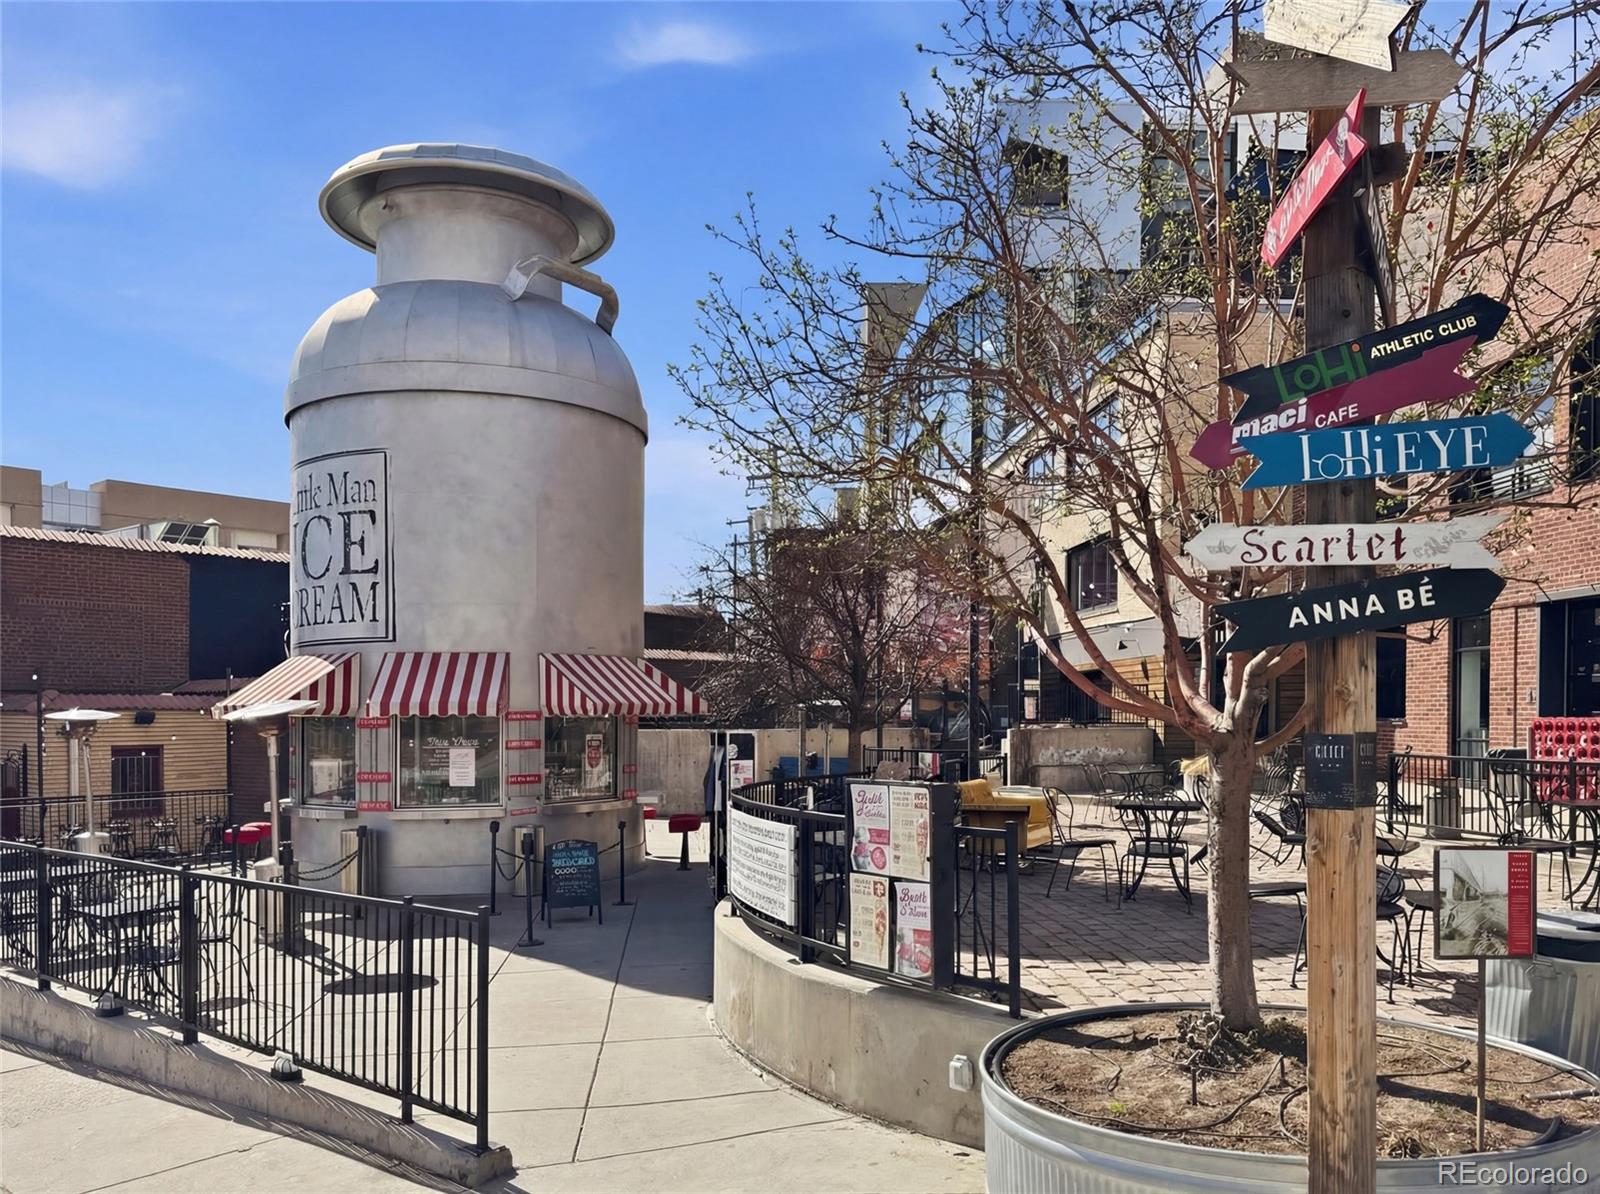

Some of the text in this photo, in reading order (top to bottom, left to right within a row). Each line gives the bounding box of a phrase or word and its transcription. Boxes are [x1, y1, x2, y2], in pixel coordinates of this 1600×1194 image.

[1370, 330, 1434, 359] ATHLETIC
[1438, 315, 1478, 337] CLUB
[1232, 398, 1360, 445] maci CAFE
[1394, 424, 1491, 475] EYE
[327, 470, 378, 506] Man
[1240, 526, 1407, 564] Scarlet
[1288, 575, 1436, 630] ANNA BÉ
